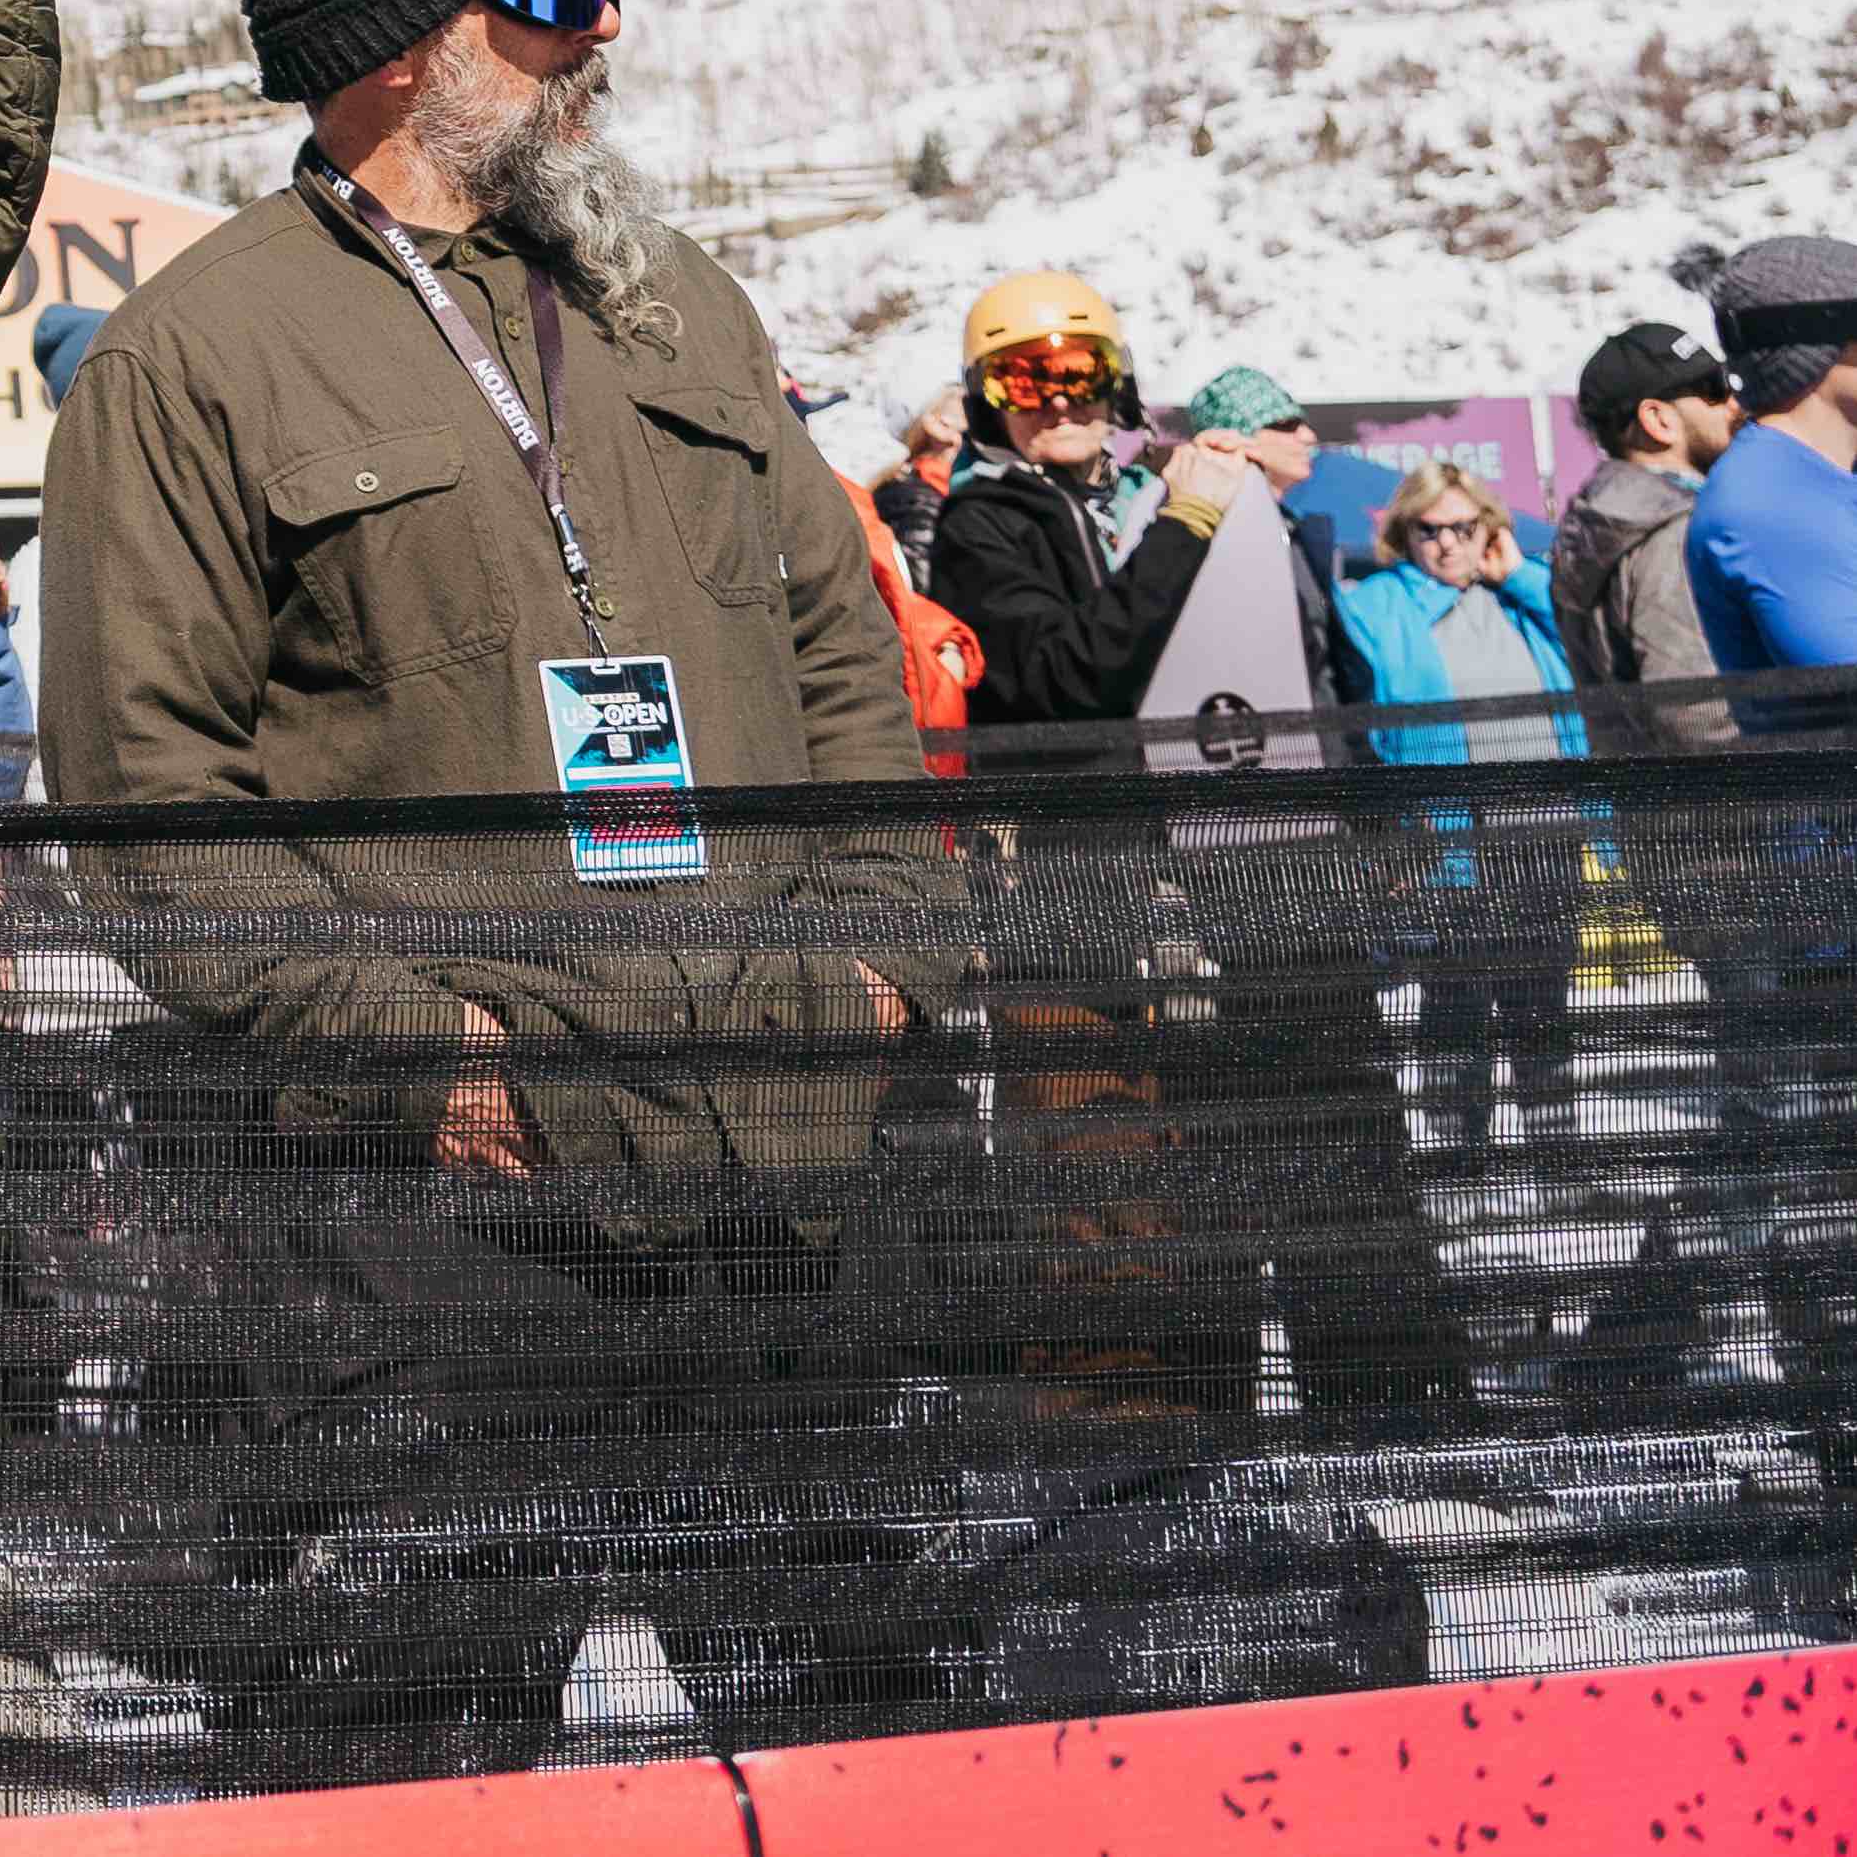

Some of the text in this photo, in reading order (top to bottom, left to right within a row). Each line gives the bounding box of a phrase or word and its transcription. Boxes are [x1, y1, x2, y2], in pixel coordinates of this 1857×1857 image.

[381, 227, 452, 311] BURTON
[471, 358, 541, 452] BURTON
[603, 701, 669, 726] OPEN
